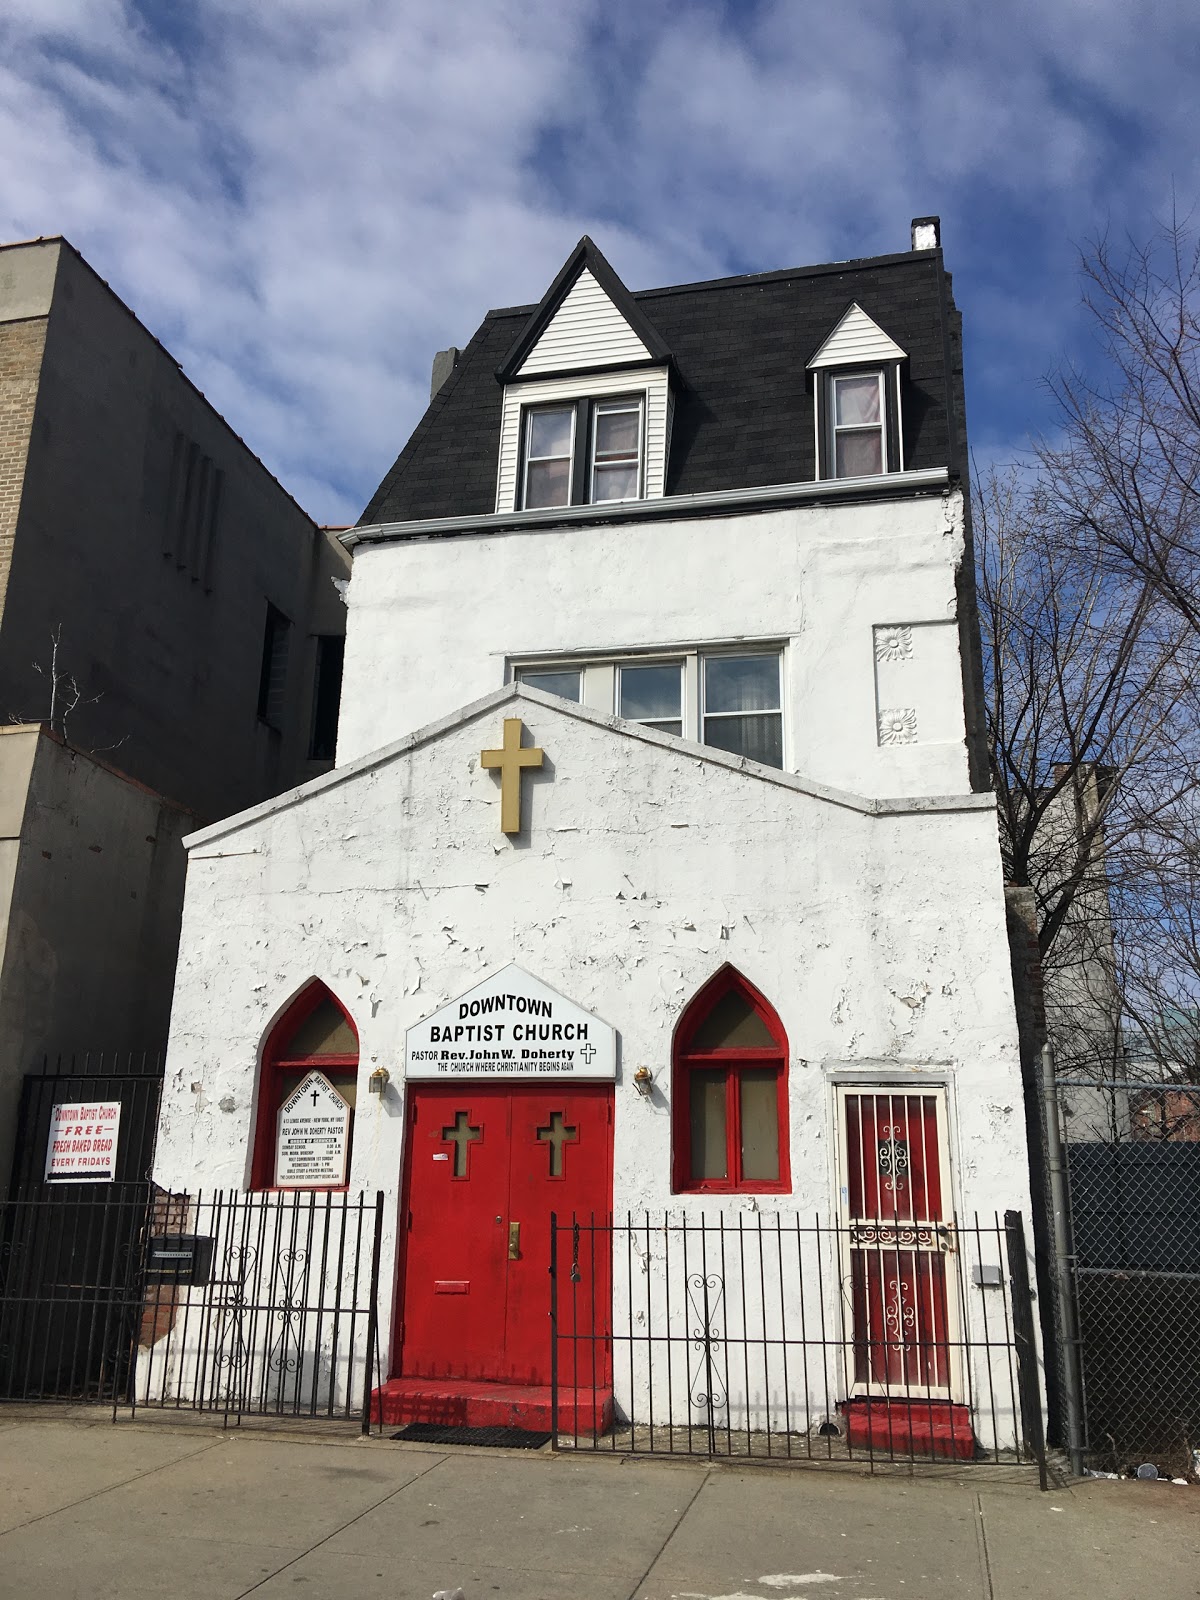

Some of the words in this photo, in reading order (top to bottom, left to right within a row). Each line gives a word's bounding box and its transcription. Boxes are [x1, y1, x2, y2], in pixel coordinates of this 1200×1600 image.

[459, 994, 553, 1020] DOWNTOWN
[430, 1024, 505, 1043] BAPTIST
[513, 1023, 589, 1041] CHURCH
[411, 1050, 438, 1061] PASTOR
[521, 1049, 575, 1062] Doherty
[438, 1062, 448, 1072] THE
[450, 1062, 474, 1072] CHURCH
[475, 1062, 496, 1072] WHERE
[496, 1061, 538, 1072] CHRISTIANITY
[538, 1061, 560, 1072] BEGINS
[560, 1061, 574, 1071] AGAIN
[284, 1077, 314, 1114] DOWNTOWN
[313, 1075, 331, 1093] BAPTIST
[328, 1092, 345, 1111] CHURCH
[65, 1125, 104, 1136] FREE
[327, 1126, 344, 1134] PASTOR
[52, 1139, 72, 1153] FRESH
[72, 1139, 92, 1153] BAKED
[93, 1138, 112, 1152] BREAD
[51, 1157, 75, 1167] EVERY
[78, 1156, 111, 1166] FRIDAYS
